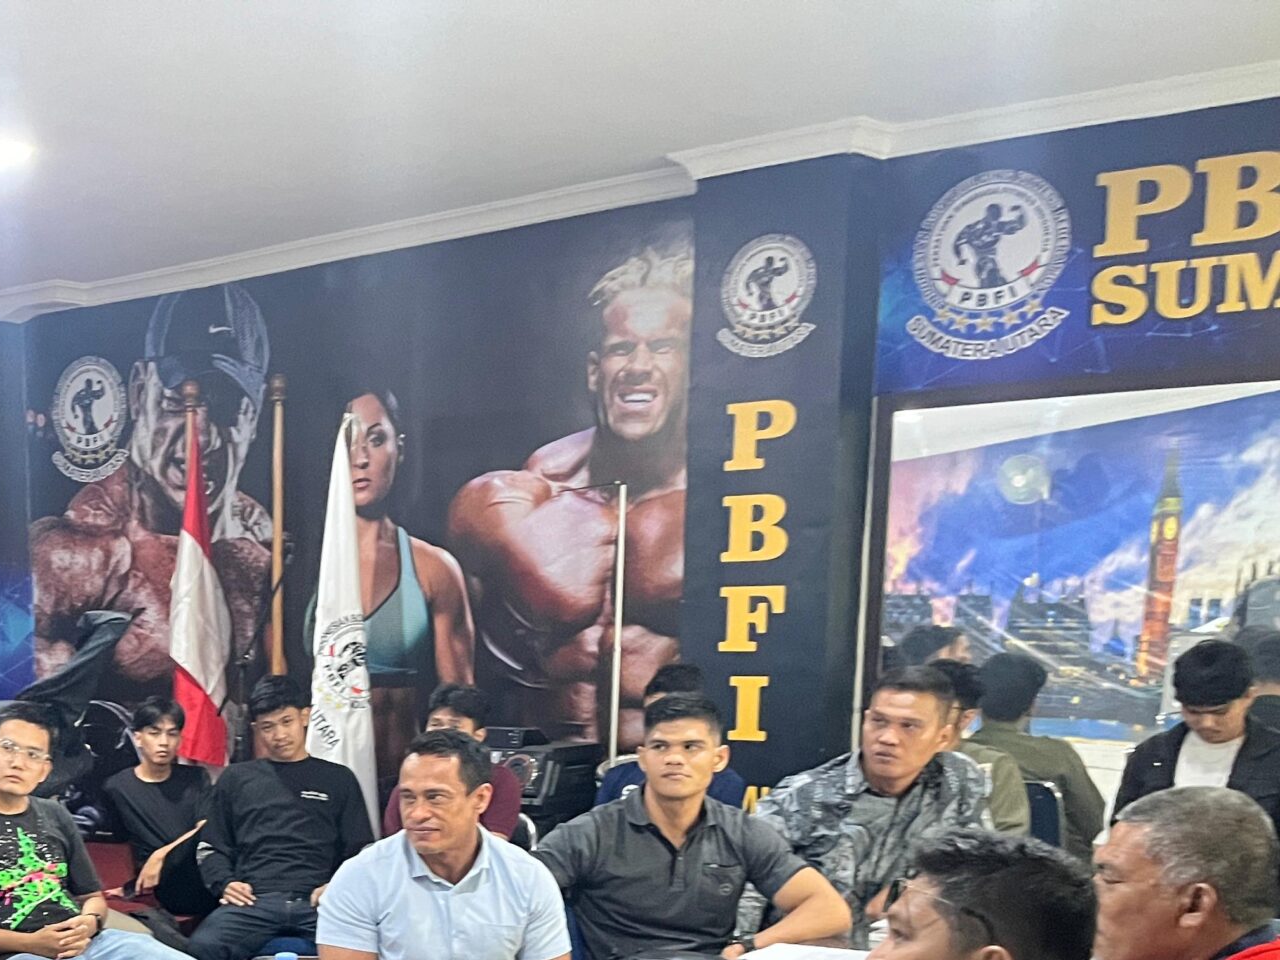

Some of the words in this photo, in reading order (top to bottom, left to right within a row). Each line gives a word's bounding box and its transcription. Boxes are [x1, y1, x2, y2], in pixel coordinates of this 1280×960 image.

[958, 285, 1019, 308] PBFI
[910, 317, 998, 357] SUMATERA
[1004, 309, 1065, 352] UTARA
[311, 709, 340, 748] UTARA
